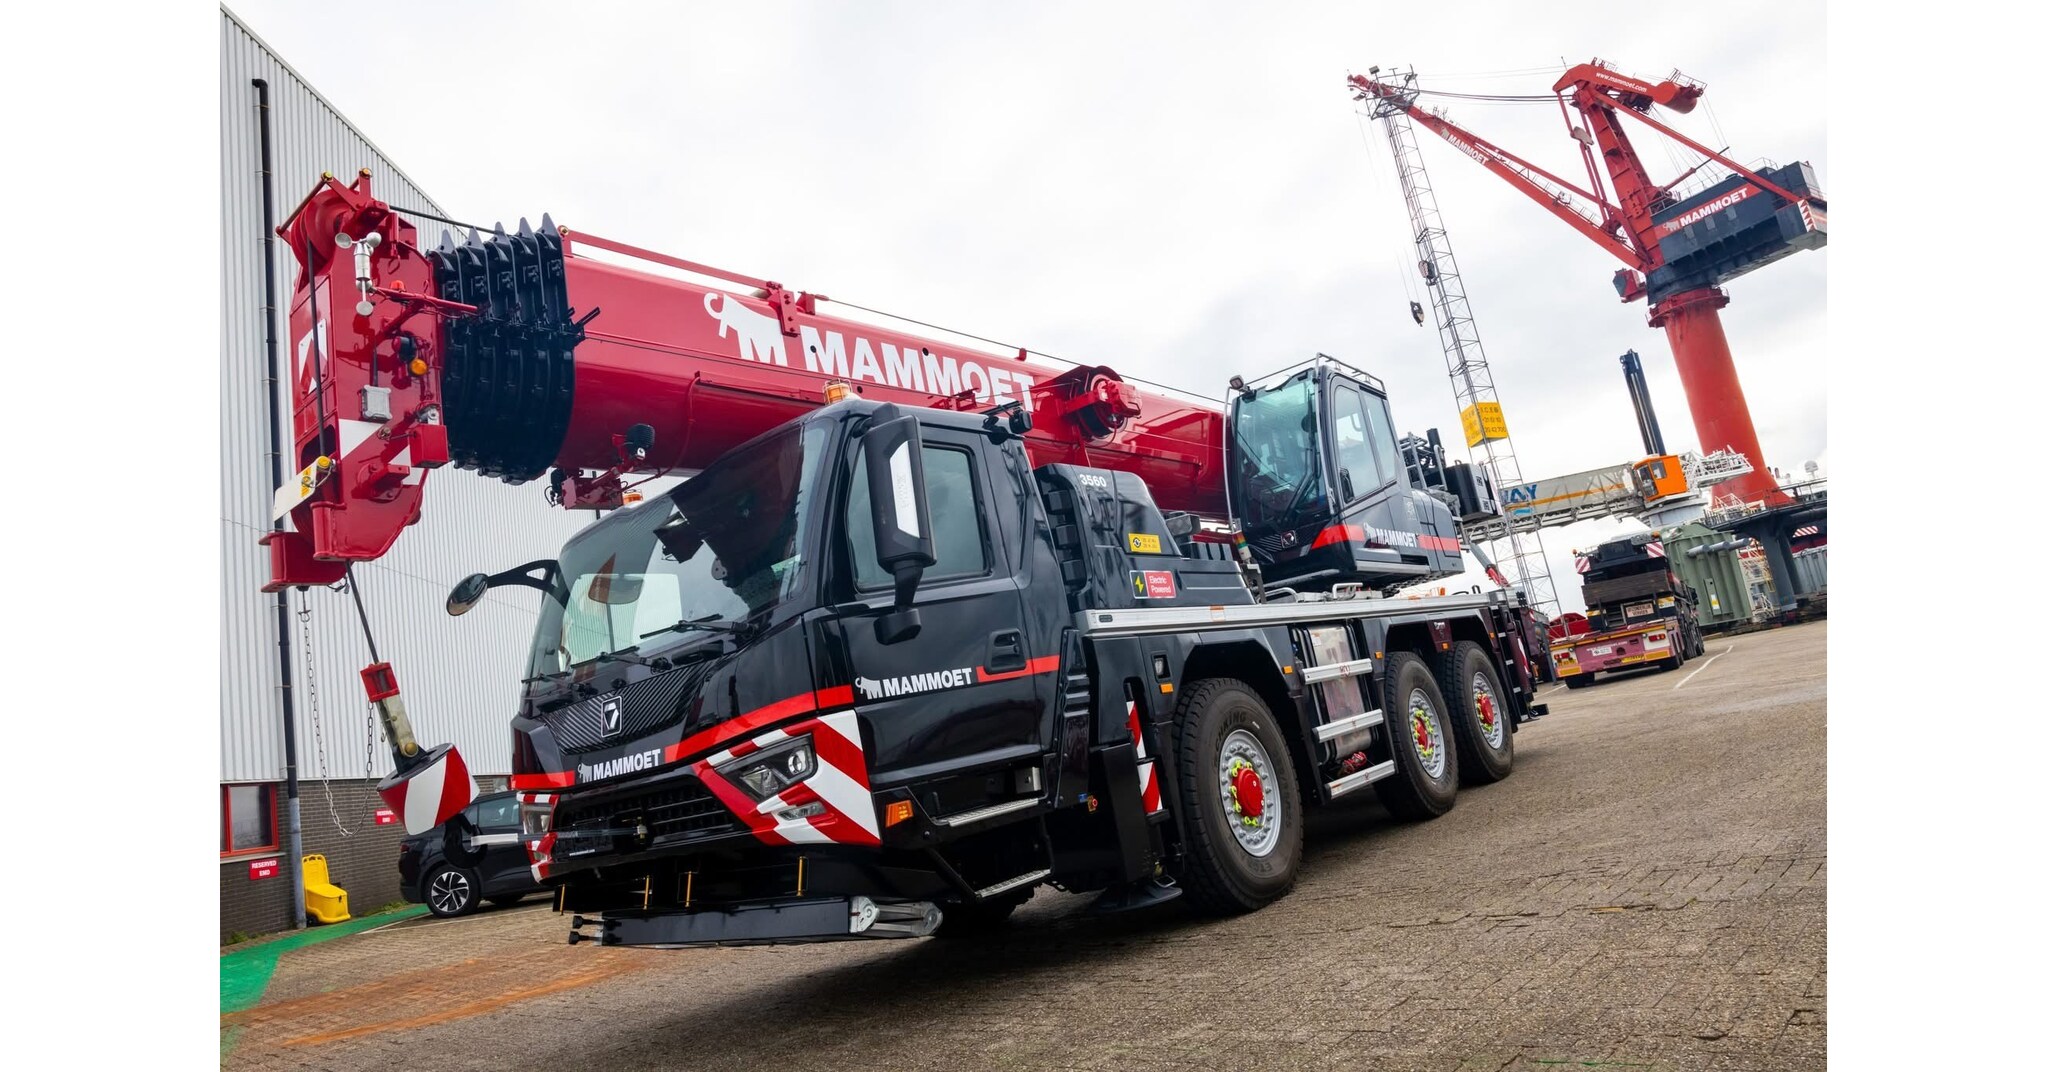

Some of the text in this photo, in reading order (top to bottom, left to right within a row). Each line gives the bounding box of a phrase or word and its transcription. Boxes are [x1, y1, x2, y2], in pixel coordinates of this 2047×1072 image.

[1448, 133, 1489, 165] MAMMOET
[1680, 187, 1748, 227] MAMMOET
[800, 325, 1036, 412] MAMMOET
[1079, 473, 1107, 487] 3560
[1375, 528, 1418, 548] MAMMOET
[1148, 575, 1167, 584] Electric
[1150, 585, 1172, 593] Powered
[882, 667, 972, 697] MAMMOET
[593, 748, 661, 781] MAMMOET
[251, 860, 277, 869] RESERVED
